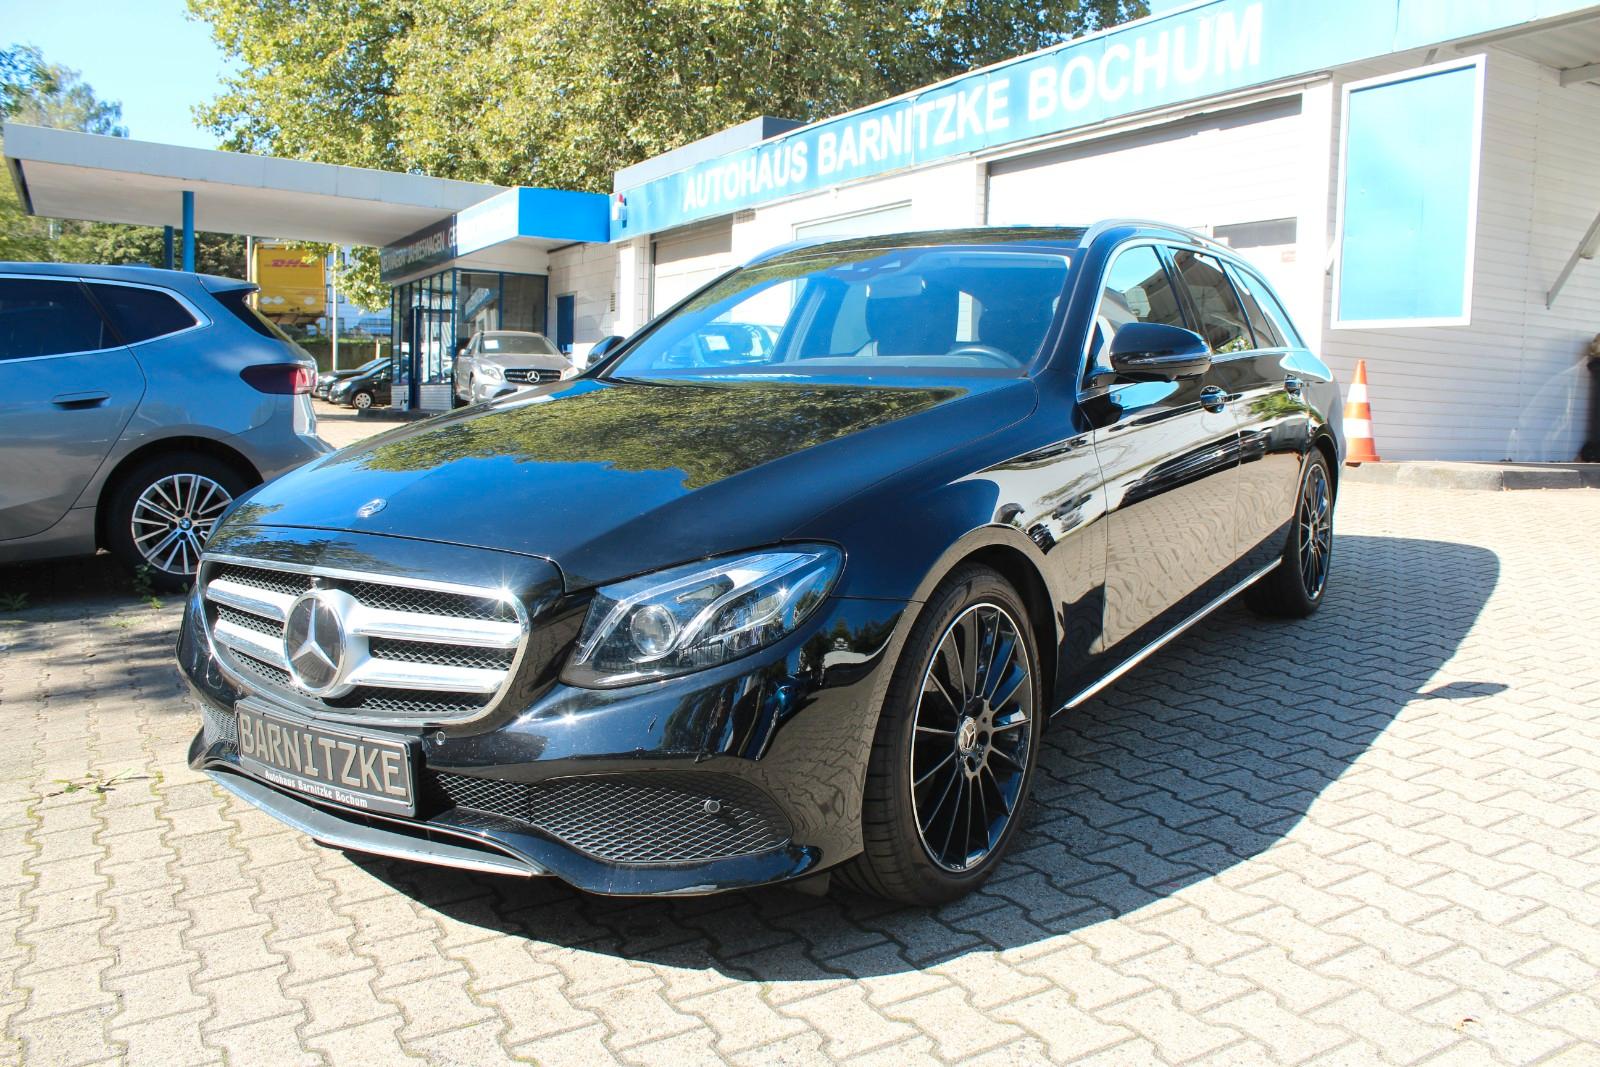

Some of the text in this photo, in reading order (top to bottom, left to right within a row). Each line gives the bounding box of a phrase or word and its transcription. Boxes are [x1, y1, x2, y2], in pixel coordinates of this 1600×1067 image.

[683, 3, 1262, 212] AUTOHAUS BARNITZKE BOCHUM
[238, 713, 408, 797] BARNITZKE
[264, 769, 368, 808] Autohaus Barnitzke Bochum
